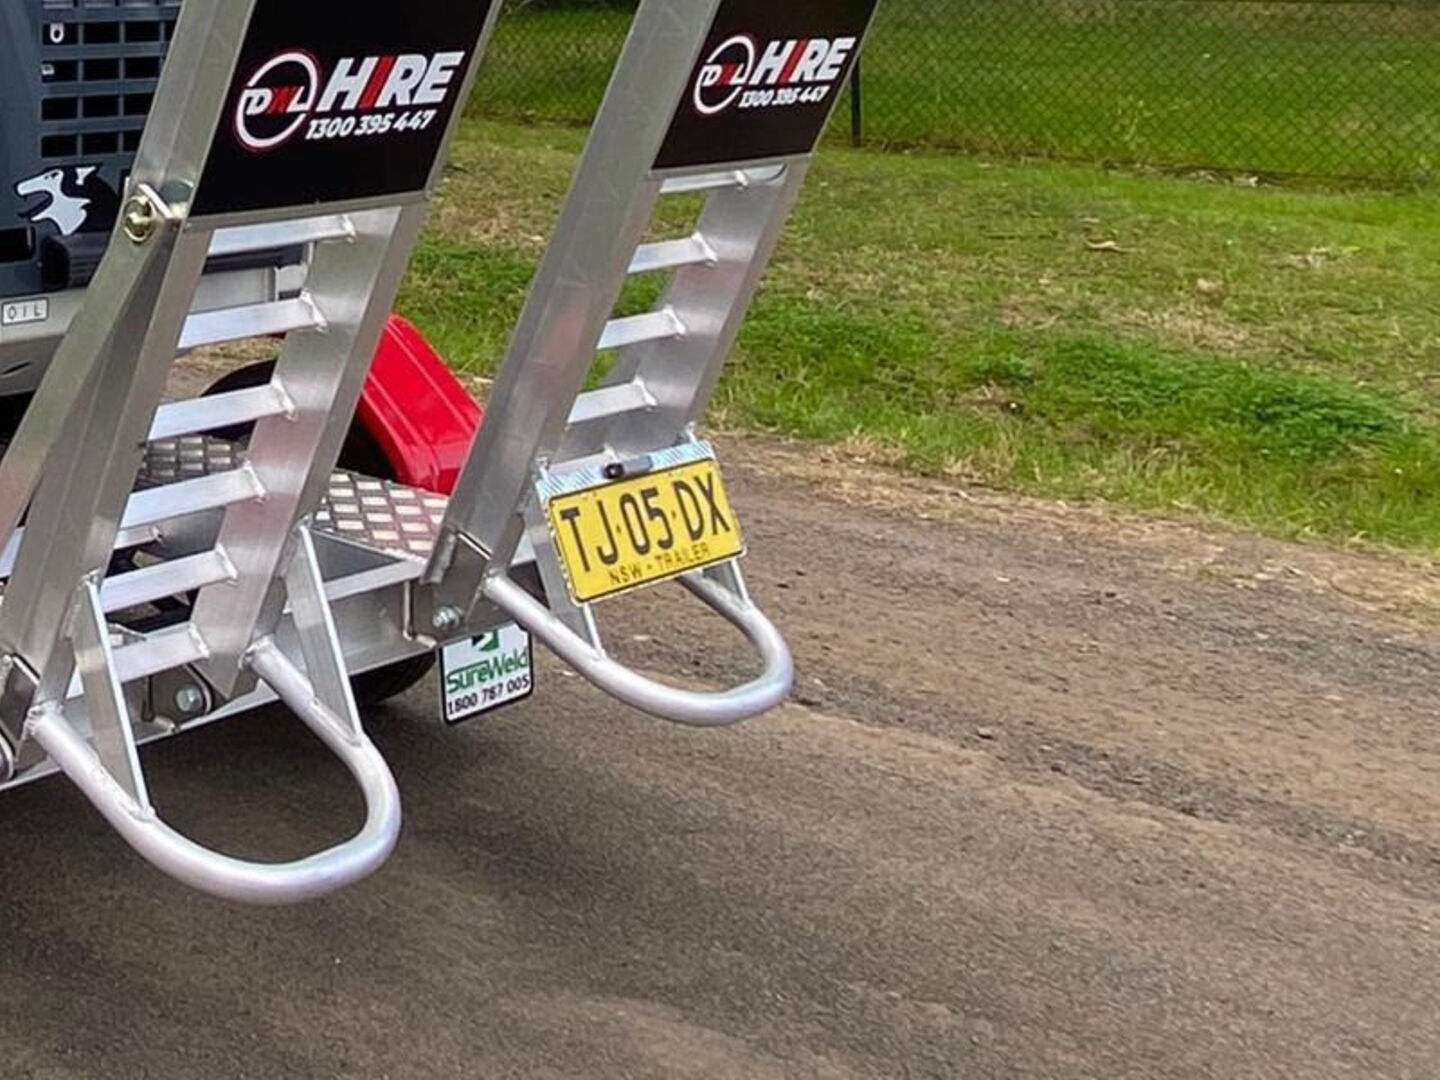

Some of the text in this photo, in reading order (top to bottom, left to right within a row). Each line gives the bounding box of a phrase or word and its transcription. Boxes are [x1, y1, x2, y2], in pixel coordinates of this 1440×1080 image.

[748, 36, 857, 86] HIRE
[243, 51, 465, 116] DWL HIRE
[738, 90, 775, 108] 1300
[798, 85, 830, 103] 447
[305, 109, 437, 140] 1300 395 447
[7, 305, 42, 320] OIL
[608, 541, 710, 585] NSW TRAILER
[446, 646, 529, 694] SureWeld
[448, 674, 530, 715] 1800 787 005
